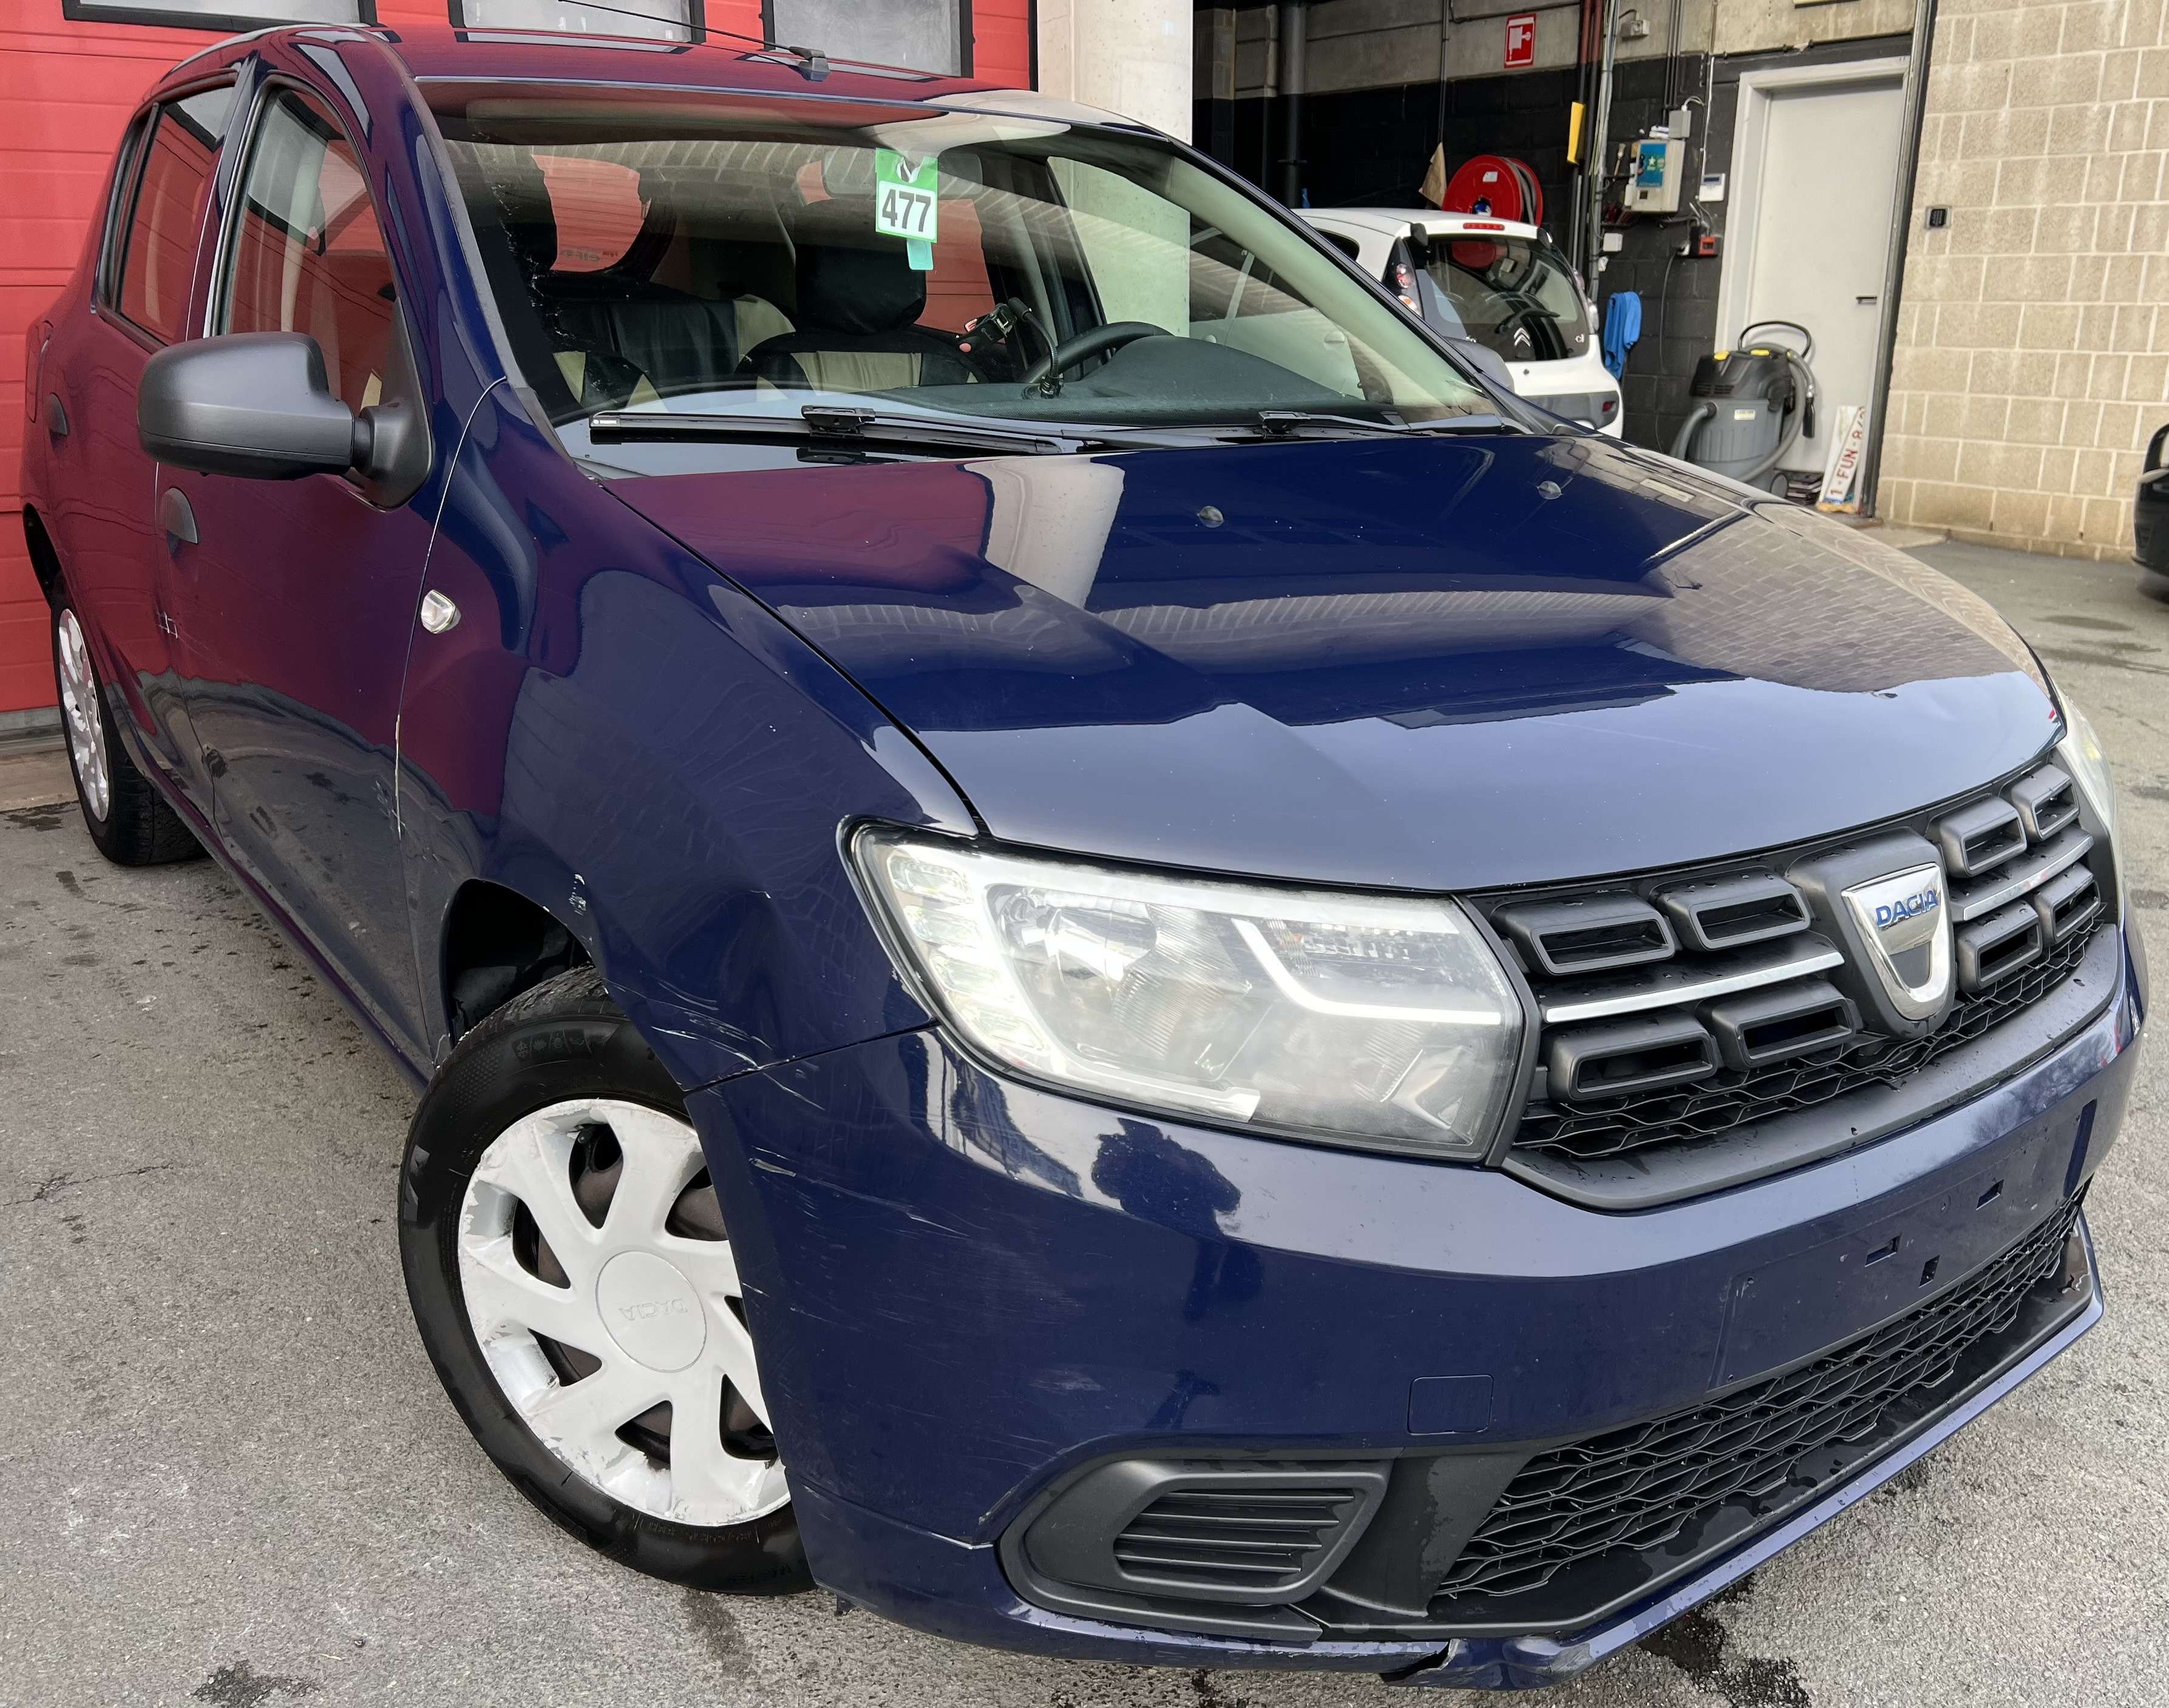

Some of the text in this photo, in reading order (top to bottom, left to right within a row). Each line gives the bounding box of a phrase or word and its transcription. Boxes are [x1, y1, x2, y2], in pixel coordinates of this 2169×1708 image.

[882, 189, 931, 232] 477
[1876, 890, 1938, 928] DACIA
[619, 1298, 688, 1321] DACIA
